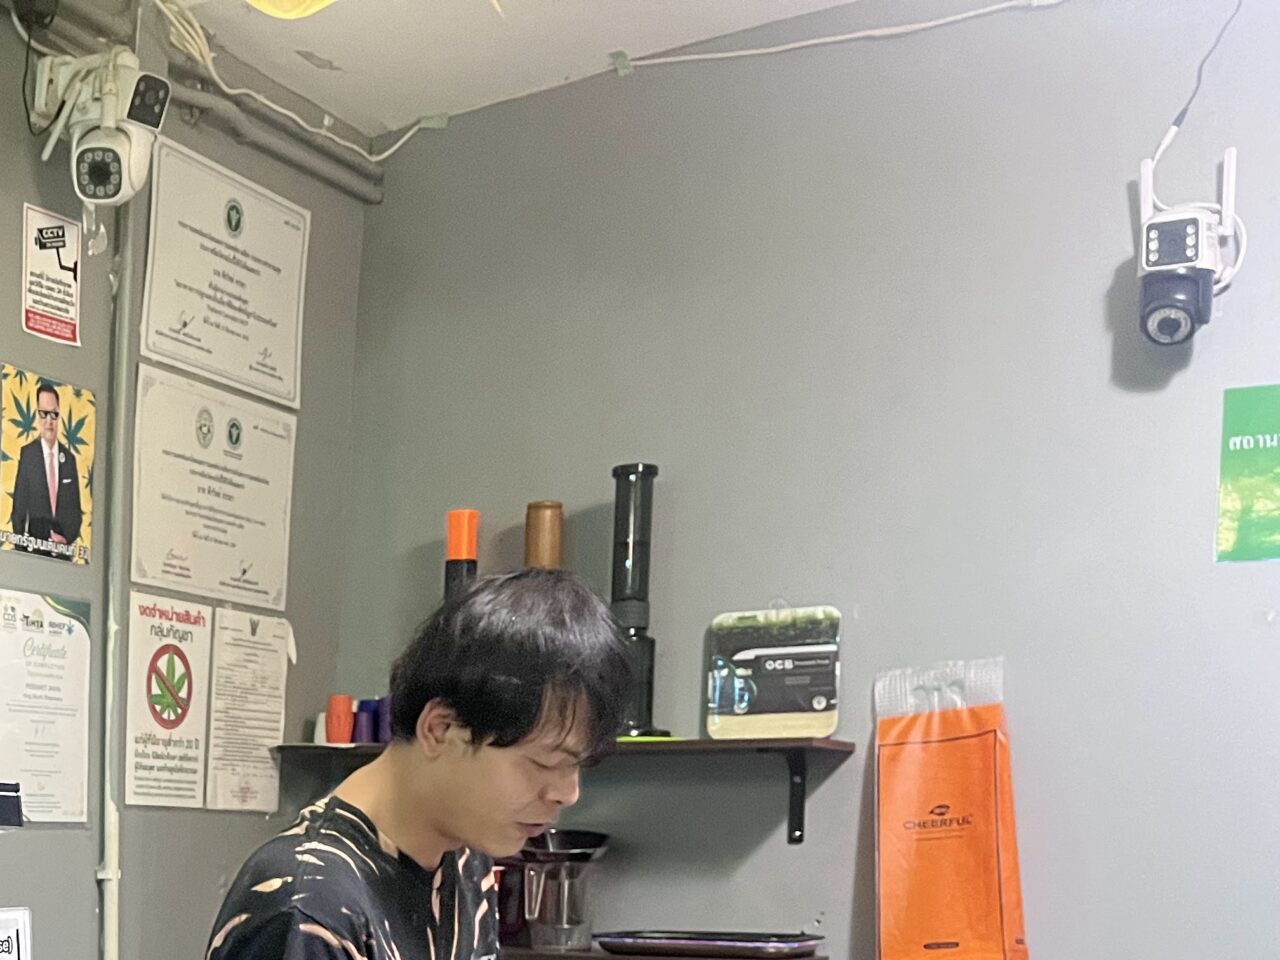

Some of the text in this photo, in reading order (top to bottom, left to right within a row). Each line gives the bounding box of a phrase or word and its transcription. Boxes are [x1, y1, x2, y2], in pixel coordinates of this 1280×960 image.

[42, 228, 63, 237] CCTV
[765, 659, 793, 670] OCB
[903, 816, 972, 830] CHEERFUL
